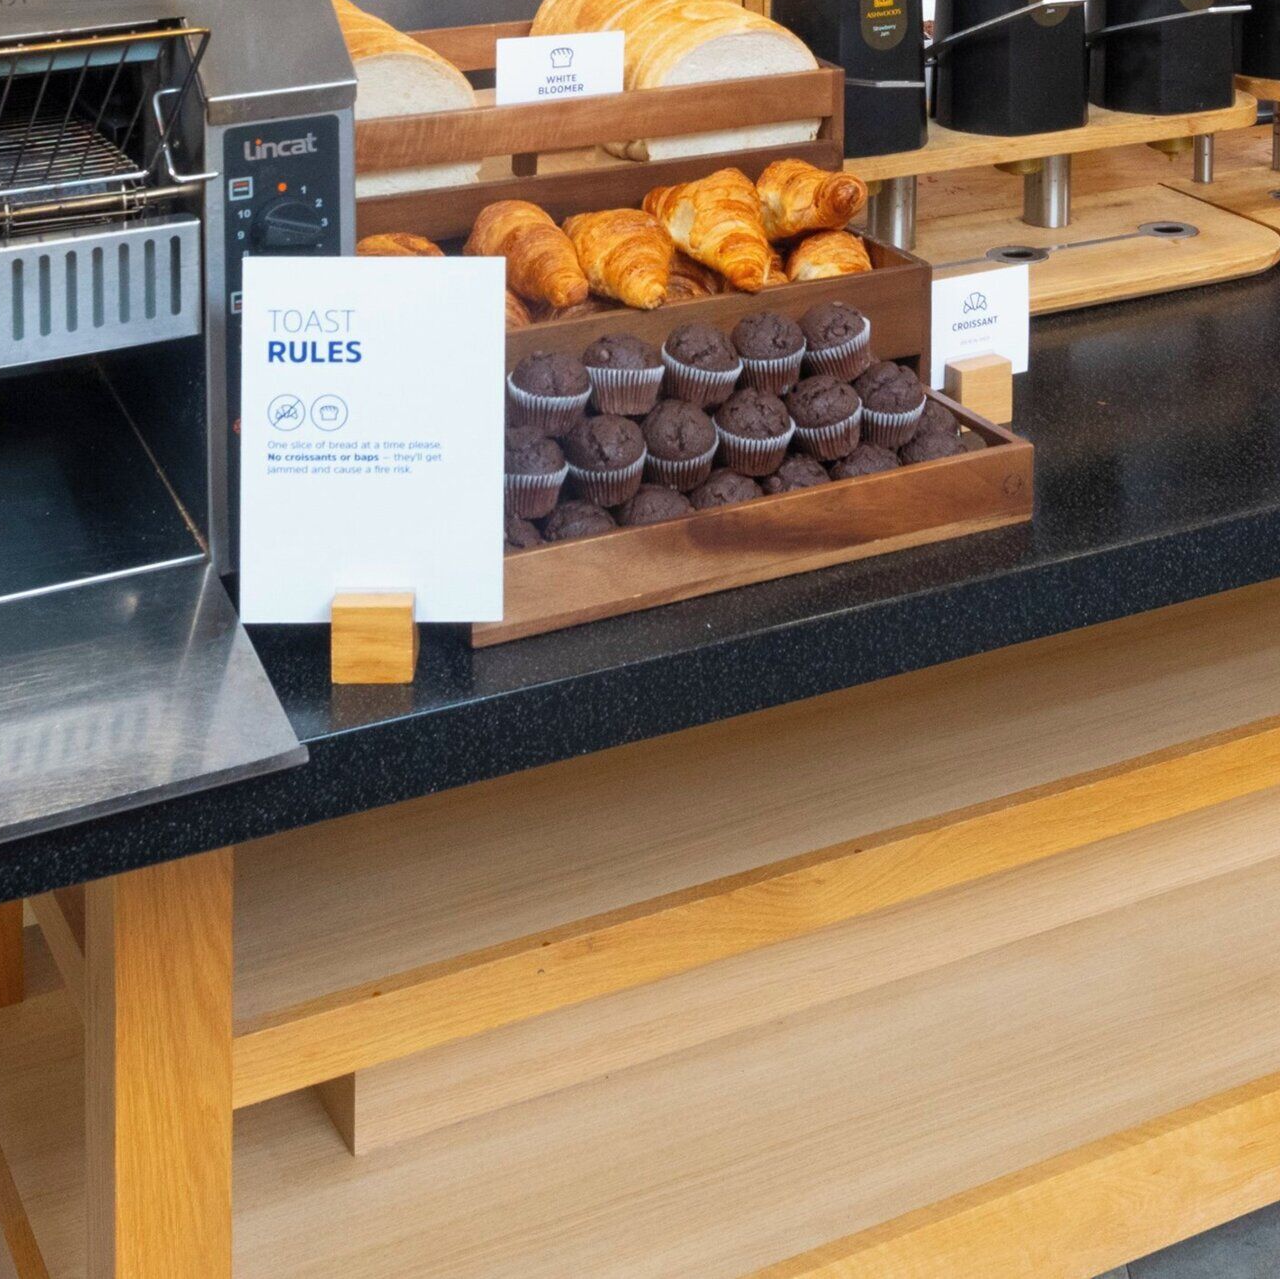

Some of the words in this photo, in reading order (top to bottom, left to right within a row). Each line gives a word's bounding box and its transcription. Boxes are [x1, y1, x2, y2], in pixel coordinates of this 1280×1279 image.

[866, 8, 902, 19] ASHWOODS
[873, 23, 896, 32] Strawberry
[546, 74, 577, 84] WHITE
[538, 83, 584, 95] BLOOMER
[243, 132, 318, 161] Lincat
[300, 185, 307, 194] 1
[315, 198, 323, 208] 2
[237, 209, 251, 219] 10
[321, 218, 329, 227] 3
[237, 231, 245, 240] 9
[267, 309, 355, 333] TOAST
[952, 315, 998, 332] CROISSANT
[268, 340, 362, 363] RULES
[267, 440, 288, 449] One
[290, 440, 312, 449] slice
[315, 440, 326, 449] of
[328, 440, 358, 449] bread
[361, 441, 371, 449] at
[383, 440, 406, 449] time
[267, 453, 282, 462] No
[285, 453, 337, 462] croissants
[340, 454, 350, 462] or
[354, 453, 379, 464] baps
[394, 453, 422, 464] they'll
[425, 453, 442, 464] get
[266, 465, 308, 476] jammed
[311, 465, 331, 474] and
[333, 466, 362, 474] cause
[375, 465, 390, 474] fire
[393, 465, 412, 474] risk.
